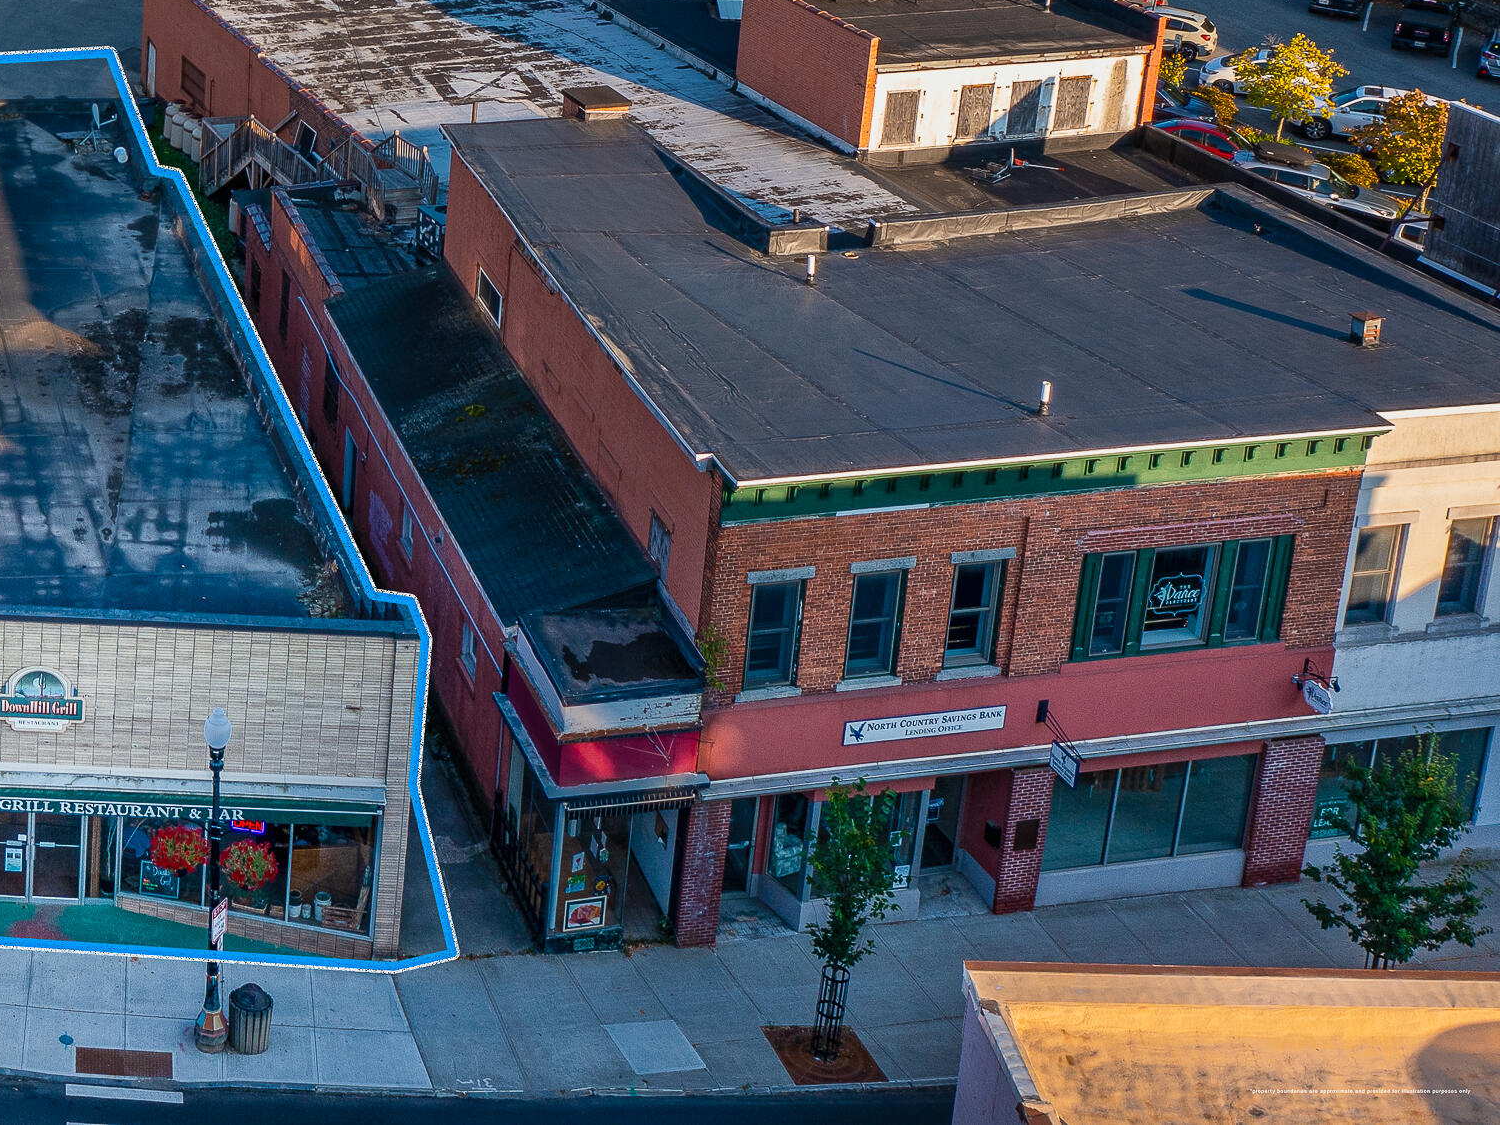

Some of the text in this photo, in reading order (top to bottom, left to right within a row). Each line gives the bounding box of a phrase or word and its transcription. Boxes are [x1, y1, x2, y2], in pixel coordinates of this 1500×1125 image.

[1167, 584, 1200, 600] Dance
[1, 699, 78, 716] DownHill Grill
[867, 711, 1002, 732] NORTH COUNTRY SAVINGS BANK
[905, 724, 963, 736] LENDING OFFICE
[0, 799, 54, 813] GRILL
[60, 801, 183, 819] RESTAURANT
[189, 808, 201, 819] &
[1320, 807, 1340, 816] FOR
[233, 820, 262, 831] OPEN
